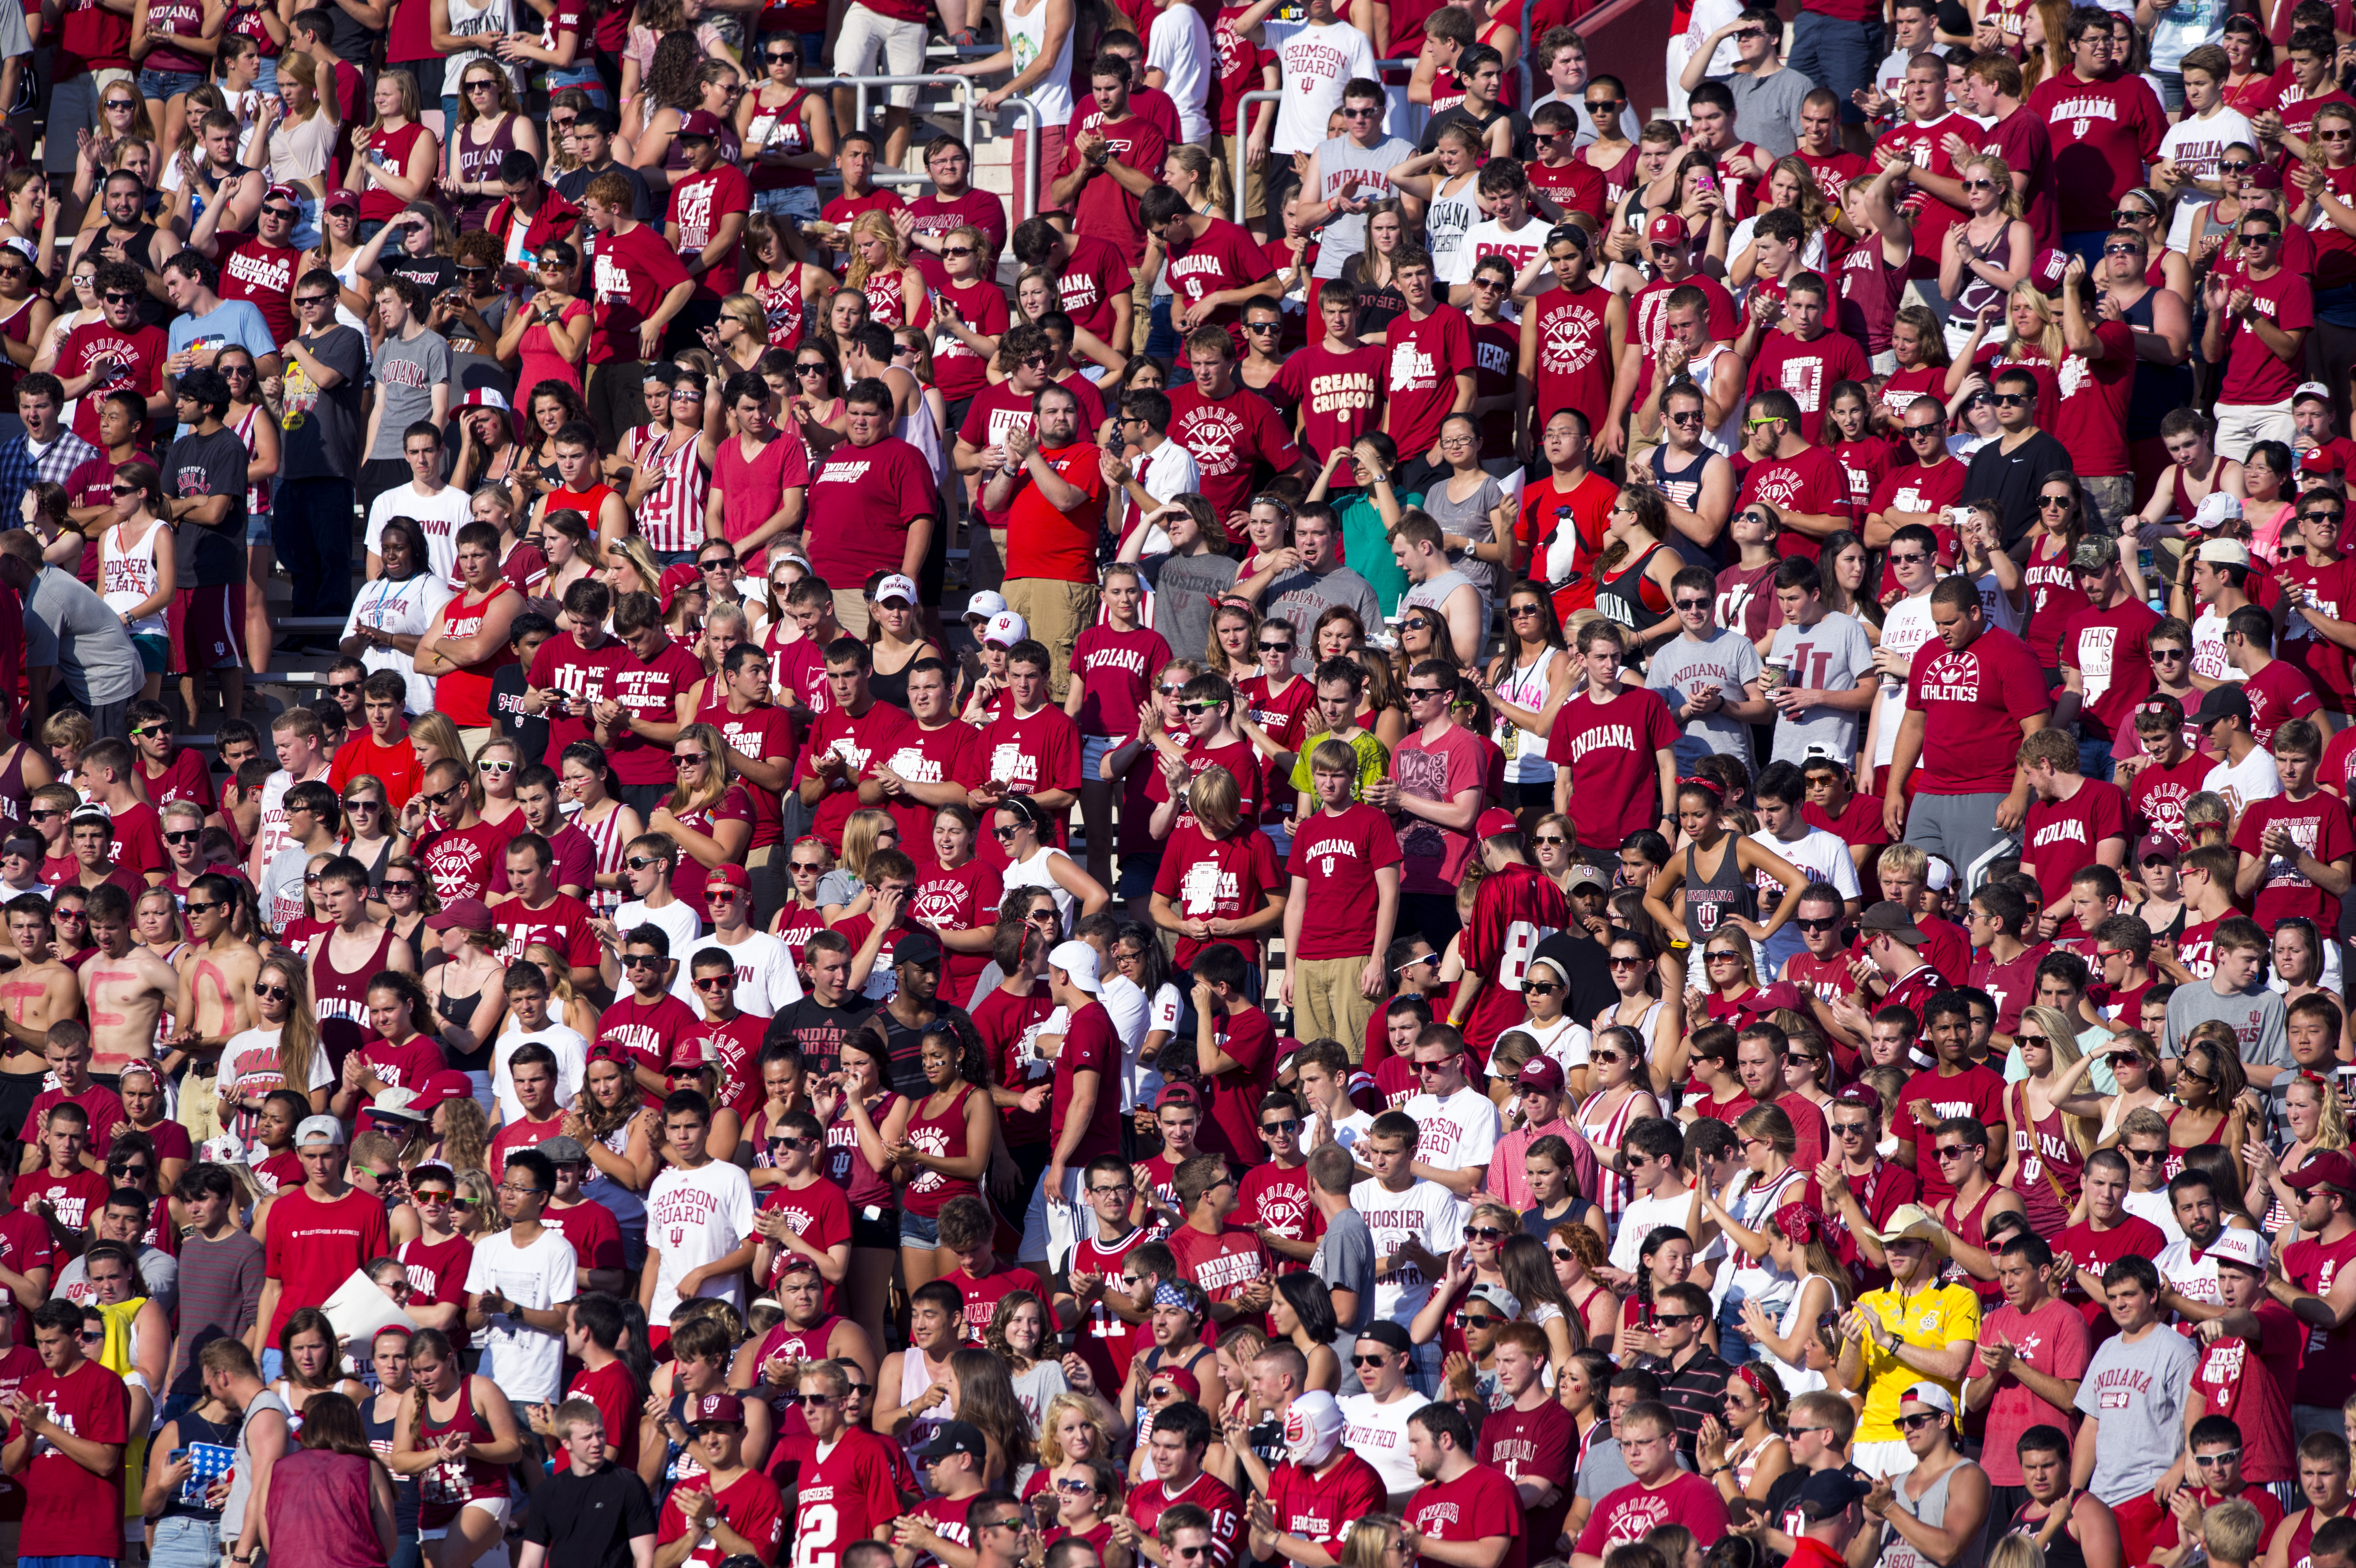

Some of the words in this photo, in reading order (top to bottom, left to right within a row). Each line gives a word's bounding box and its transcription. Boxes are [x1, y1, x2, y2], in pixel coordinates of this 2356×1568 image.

[148, 6, 198, 22] NDIANA
[227, 13, 261, 31] INDIANA
[560, 13, 578, 24] PINK
[1280, 8, 1303, 19] NOT
[1285, 44, 1347, 69] CRIMSON
[1288, 60, 1336, 79] GUARD
[2049, 99, 2116, 124] INDIANA
[2175, 141, 2222, 161] INDIANA
[1812, 167, 1848, 193] IANA
[914, 214, 964, 229] NDIANA
[230, 252, 290, 282] INDIANA
[1172, 254, 1225, 276] INDIANA
[227, 265, 285, 293] FOOTBALL
[1058, 274, 1094, 294] IANA
[1064, 292, 1097, 311] ERSITY
[1359, 294, 1407, 311] OOSIER
[1539, 305, 1599, 330] INDIANA
[80, 338, 139, 363] INDIANA
[1541, 348, 1598, 374] FOOTBALL
[1783, 358, 1816, 369] HOOSIER
[1311, 373, 1367, 395] CREAN
[1368, 379, 1374, 392] &
[1811, 366, 1822, 411] HYSTERIA
[1313, 392, 1374, 413] CRIMSON
[993, 411, 1031, 428] THIS
[1179, 406, 1243, 433] INDIANA
[825, 461, 870, 473] INDIANA
[1755, 468, 1803, 493] INDIANA
[883, 582, 911, 594] INDIANA
[1900, 617, 1917, 626] THE
[1886, 629, 1931, 644] OURNEY
[2082, 629, 2115, 648] THIS
[1927, 653, 1977, 677] INDIANA
[2103, 649, 2110, 662] IS
[616, 672, 646, 684] DON'T
[646, 672, 669, 683] CALL
[1671, 664, 1728, 688] INDIANA
[2080, 664, 2110, 675] NDIANA
[628, 683, 639, 694] IT
[642, 685, 648, 694] A
[1921, 685, 1978, 703] ATHLETICS
[617, 694, 665, 708] OMEBACK
[1248, 709, 1288, 725] OOSIERS
[730, 733, 762, 744] FROM
[1571, 724, 1636, 763] INDIANA
[2303, 817, 2319, 826] TOP
[263, 830, 293, 865] 25
[426, 838, 481, 862] INDIANA
[1306, 838, 1357, 863] INDIANA
[1182, 873, 1238, 888] INDIANA
[914, 880, 970, 904] INDIANA
[1182, 885, 1239, 900] FOOTBALL
[1686, 889, 1734, 903] INDIANA
[1498, 921, 1561, 992] 8
[2179, 943, 2213, 961] AN'T
[1924, 974, 1939, 987] 7
[88, 971, 138, 1064] E
[316, 999, 371, 1029] NDIANA
[1164, 1003, 1176, 1021] 5
[709, 1034, 746, 1062] IANA
[1363, 1209, 1425, 1230] HOOSIER
[2219, 1239, 2247, 1252] NDIANA
[1195, 1251, 1262, 1278] INDIANA
[2171, 1278, 2216, 1296] OOSIERS
[1091, 1301, 1125, 1338] 11
[2094, 1369, 2152, 1394] INDIANA
[1374, 1429, 1396, 1448] FRED
[798, 1486, 834, 1505] HOOSIERS
[1415, 1502, 1460, 1524] INDIANA
[1609, 1496, 1668, 1523] INDIANA
[1211, 1508, 1237, 1537] 15
[1888, 1553, 1915, 1568] 1820
